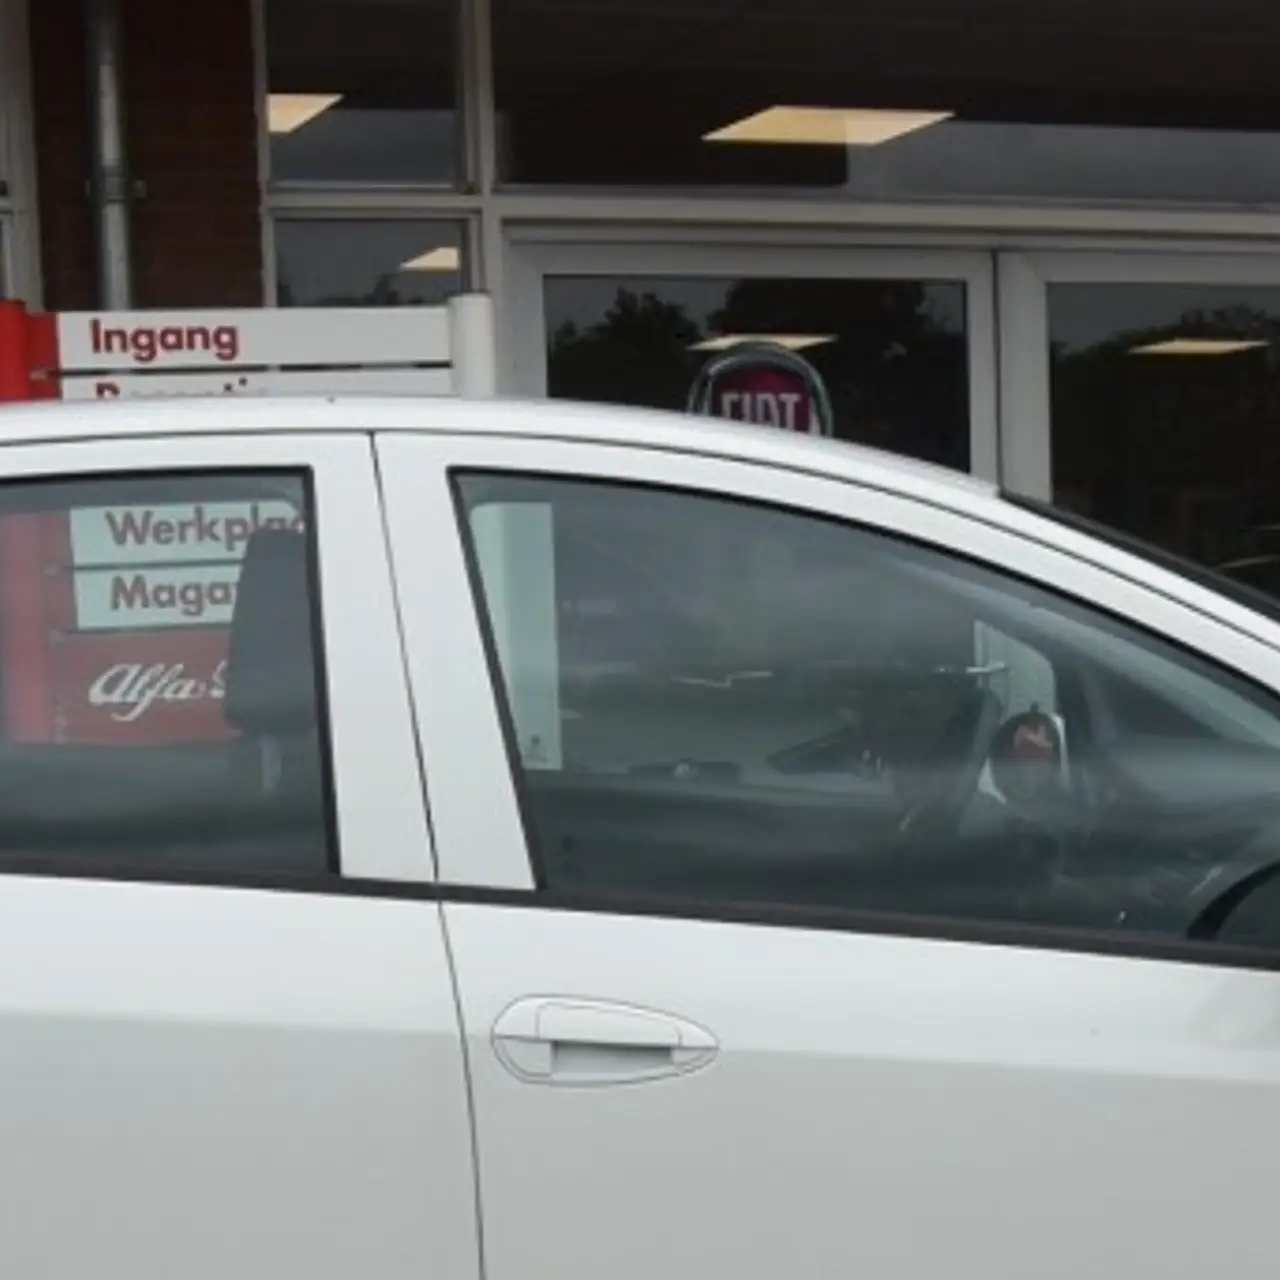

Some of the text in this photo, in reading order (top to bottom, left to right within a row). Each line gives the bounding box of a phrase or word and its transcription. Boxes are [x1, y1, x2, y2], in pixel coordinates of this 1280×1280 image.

[90, 318, 238, 362] Ingang
[721, 392, 801, 431] FIAT
[110, 573, 238, 617] Maga
